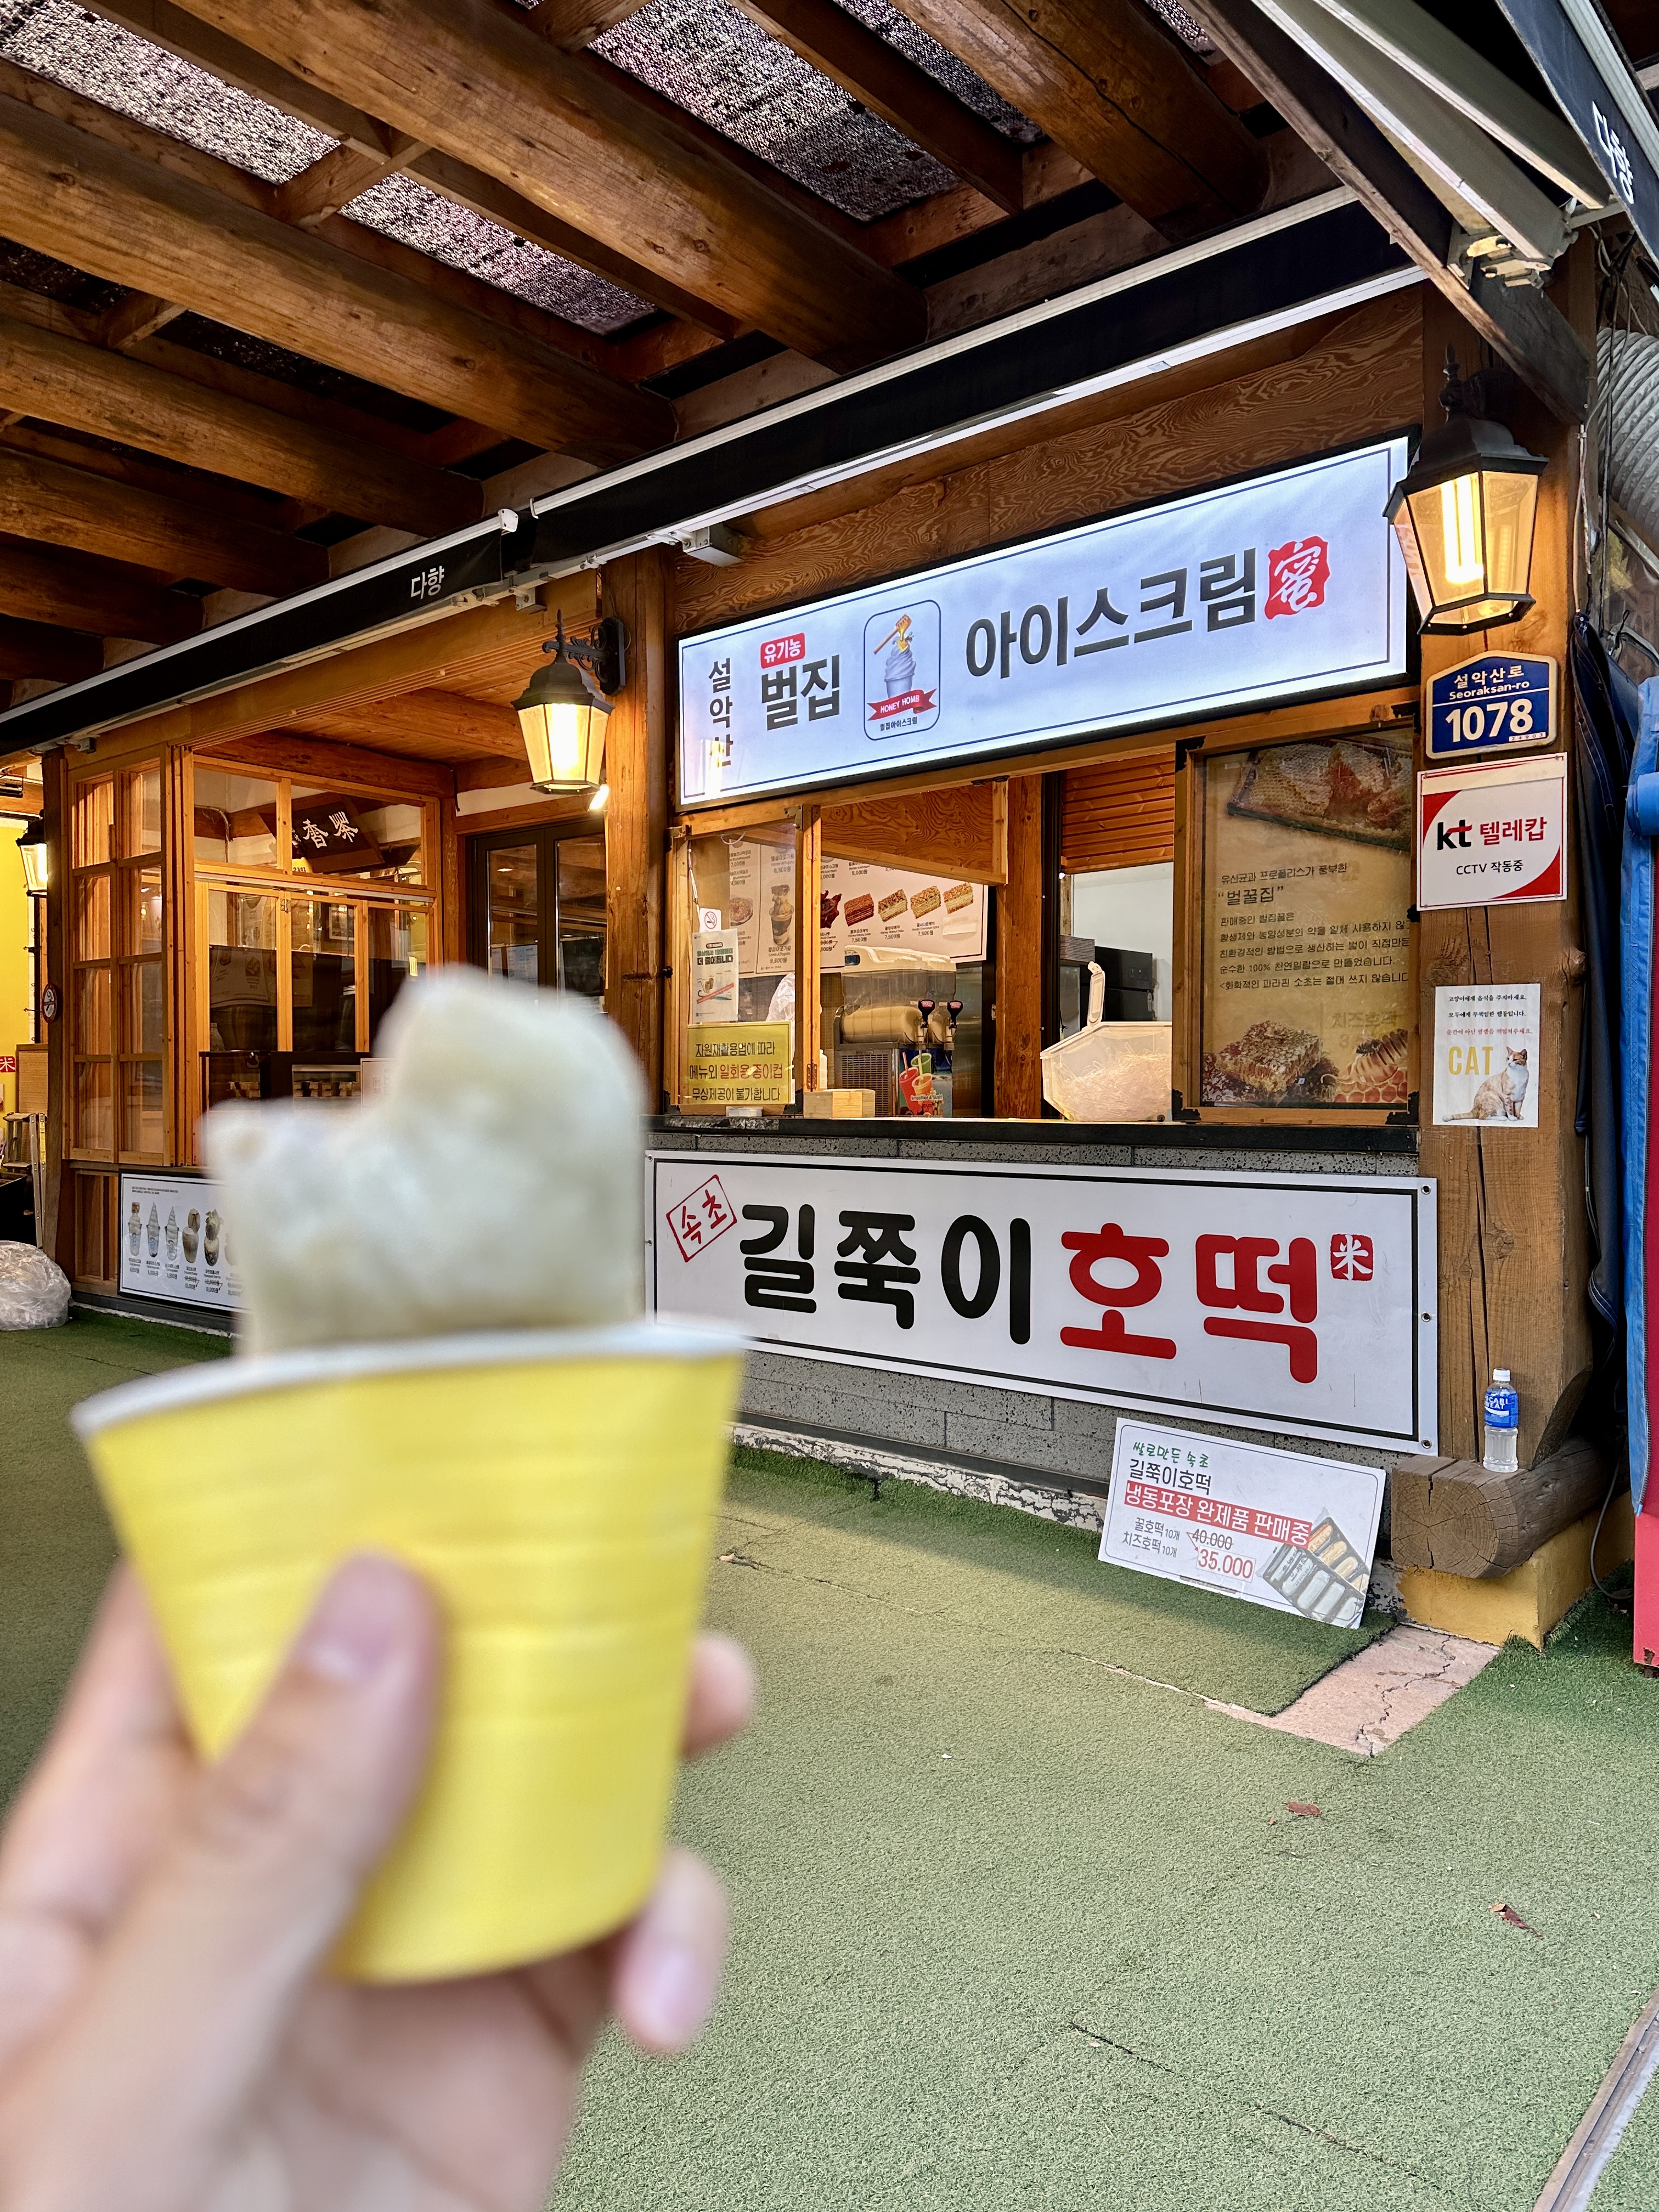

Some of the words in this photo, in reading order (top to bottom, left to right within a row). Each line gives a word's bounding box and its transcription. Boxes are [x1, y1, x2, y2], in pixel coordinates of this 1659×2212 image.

[411, 565, 445, 599] 다향
[761, 654, 840, 731] 벌집
[966, 548, 1256, 679] 아이스크림
[764, 639, 802, 663] 유기농
[1454, 664, 1525, 690] 설악산로
[1449, 680, 1530, 701] Seoraksan-ro
[880, 700, 900, 713] HONEY
[902, 695, 920, 707] HOMB
[880, 716, 917, 731] 벌집아이스크림
[1445, 698, 1534, 743] 1078
[1436, 819, 1472, 851] kt
[1480, 816, 1548, 846] 텔레캅
[1221, 872, 1256, 885] 유산균과
[1260, 866, 1314, 881] 프로폴리스가
[1318, 862, 1348, 875] 풍부한
[1455, 864, 1487, 876] CCTV
[1490, 860, 1524, 873] 작동중
[1221, 915, 1255, 927] 판매중인
[1259, 912, 1295, 923] 벌집꿀은
[1307, 926, 1326, 935] 약을
[1352, 921, 1391, 933] 사용하지
[1220, 947, 1263, 958] 친환경적인
[1267, 944, 1304, 955] 방법으로
[1307, 942, 1344, 953] 생산하는
[1348, 940, 1368, 950] 벌이
[1220, 964, 1245, 974] 순수한
[1249, 963, 1271, 972] 100%
[1274, 959, 1330, 971] 천연밀랍으로
[1334, 956, 1396, 968] 만들었습니다.
[1263, 978, 1290, 988] 파라핀
[1294, 976, 1322, 987] 소초는
[1326, 975, 1344, 985] 절대
[1348, 974, 1368, 984] 쓰지
[695, 1042, 755, 1057] 자원재활용법에
[757, 1041, 776, 1056] 따라
[1448, 1046, 1494, 1075] CAT
[689, 1064, 718, 1080] 메뉴외
[720, 1064, 750, 1079] 일회용
[752, 1063, 783, 1079] 종이컵
[692, 1087, 734, 1101] 무상제공이
[736, 1087, 781, 1101] 불가합니다
[681, 1189, 728, 1244] 속초
[1333, 1234, 1372, 1279] 米
[1485, 1395, 1508, 1406] OCARI
[1485, 1401, 1505, 1409] WEAT
[1133, 1441, 1182, 1464] 쌀로만든
[1187, 1451, 1209, 1468] 속초
[1130, 1458, 1211, 1496] 길쭉이호떡
[1126, 1482, 1193, 1517] 냉동포장
[1197, 1499, 1250, 1532] 완제품
[1254, 1512, 1310, 1545] 판매중
[1134, 1517, 1164, 1537] 꿀호떡
[1165, 1528, 1181, 1541] 10개
[1192, 1528, 1233, 1550] 40.000
[1122, 1531, 1162, 1554] 치즈호떡
[1162, 1545, 1178, 1558] 10개
[1198, 1549, 1254, 1579] 35.000
